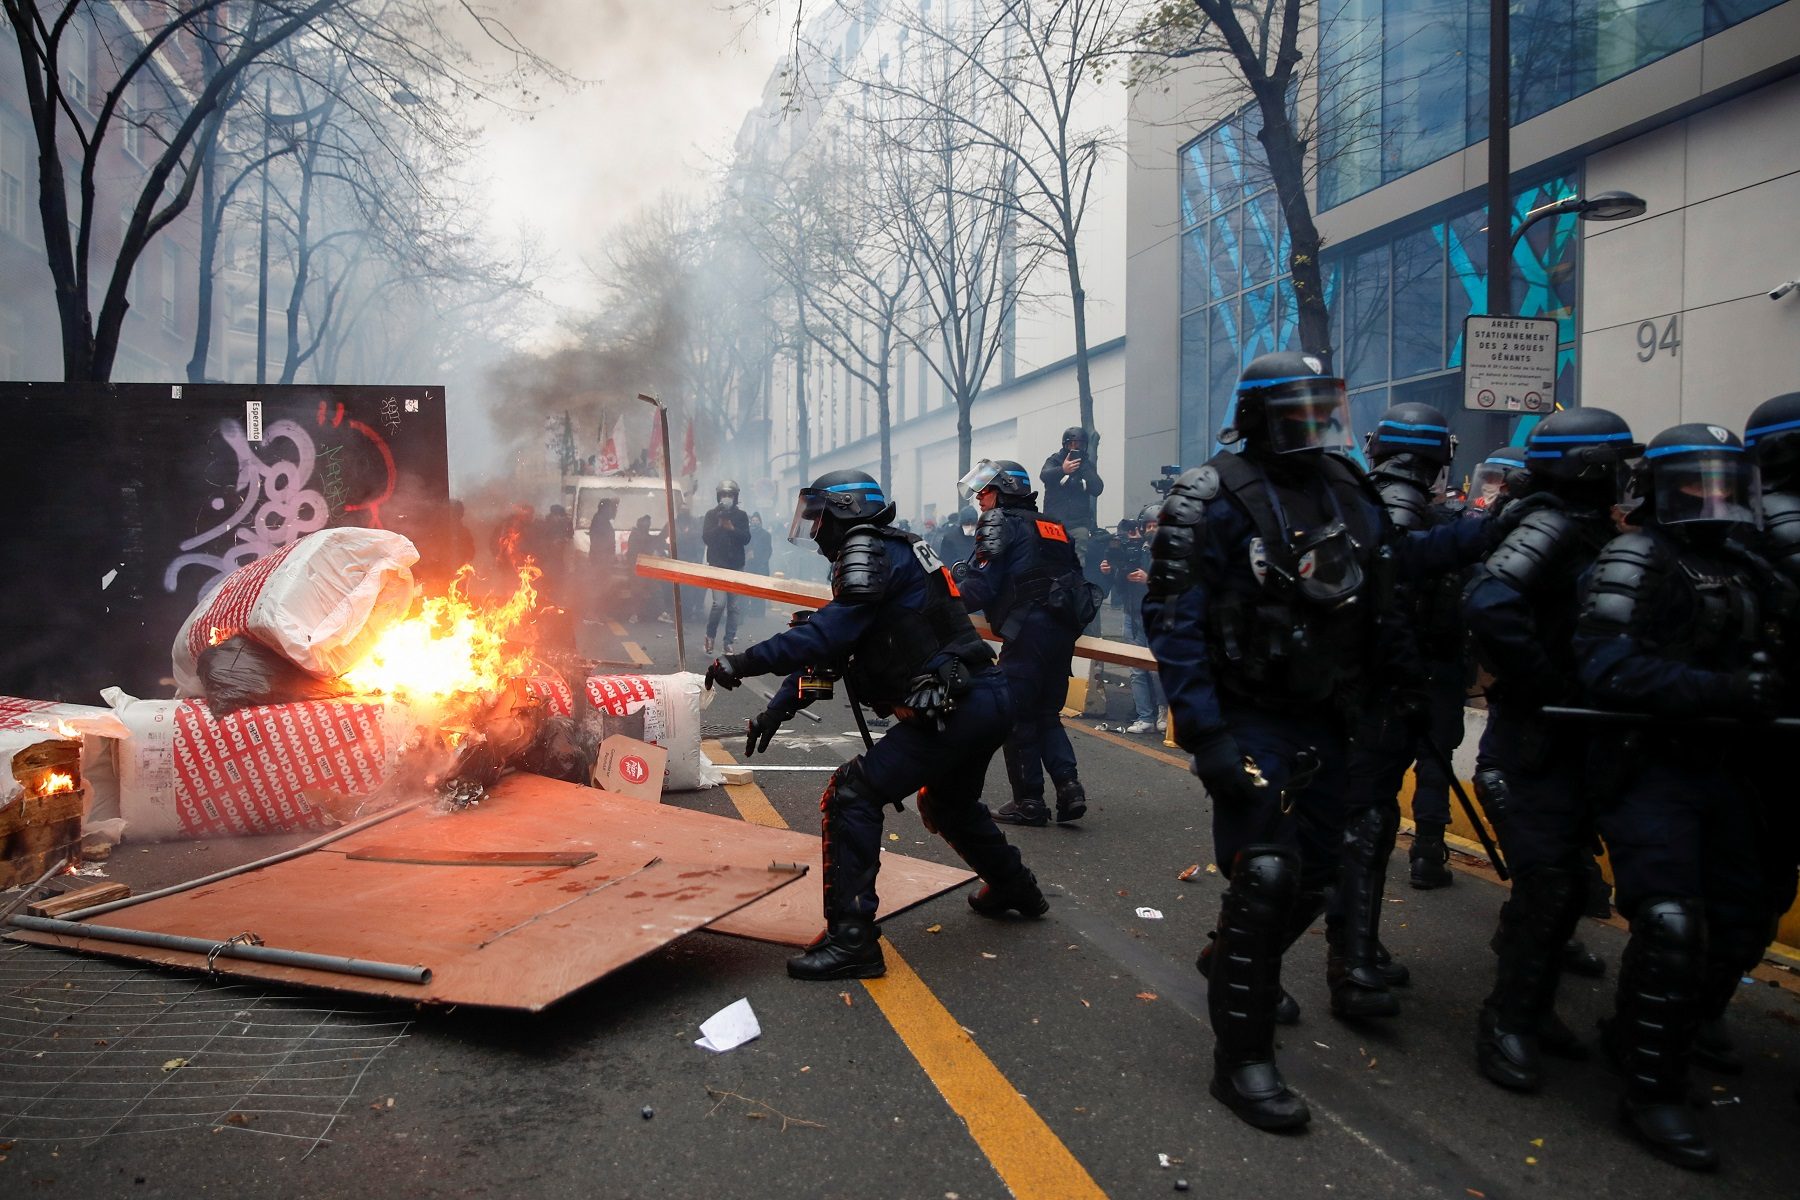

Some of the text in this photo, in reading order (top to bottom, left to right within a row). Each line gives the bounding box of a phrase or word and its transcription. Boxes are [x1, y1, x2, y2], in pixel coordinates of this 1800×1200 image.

[1474, 330, 1550, 341] STATIONNEMENT
[1479, 342, 1497, 350] DES
[1513, 344, 1545, 352] ROUES
[1524, 322, 1535, 330] ET
[1637, 314, 1681, 363] 94
[251, 402, 260, 440] Esperanto
[1044, 525, 1061, 537] 122
[186, 713, 224, 790] ROCKWOOL
[224, 713, 279, 824] ROCKWOOL ROCK
[263, 715, 301, 791] ROCKWOOL
[280, 709, 317, 784] ROCKWOOL
[257, 745, 295, 819] ROCKWOOL
